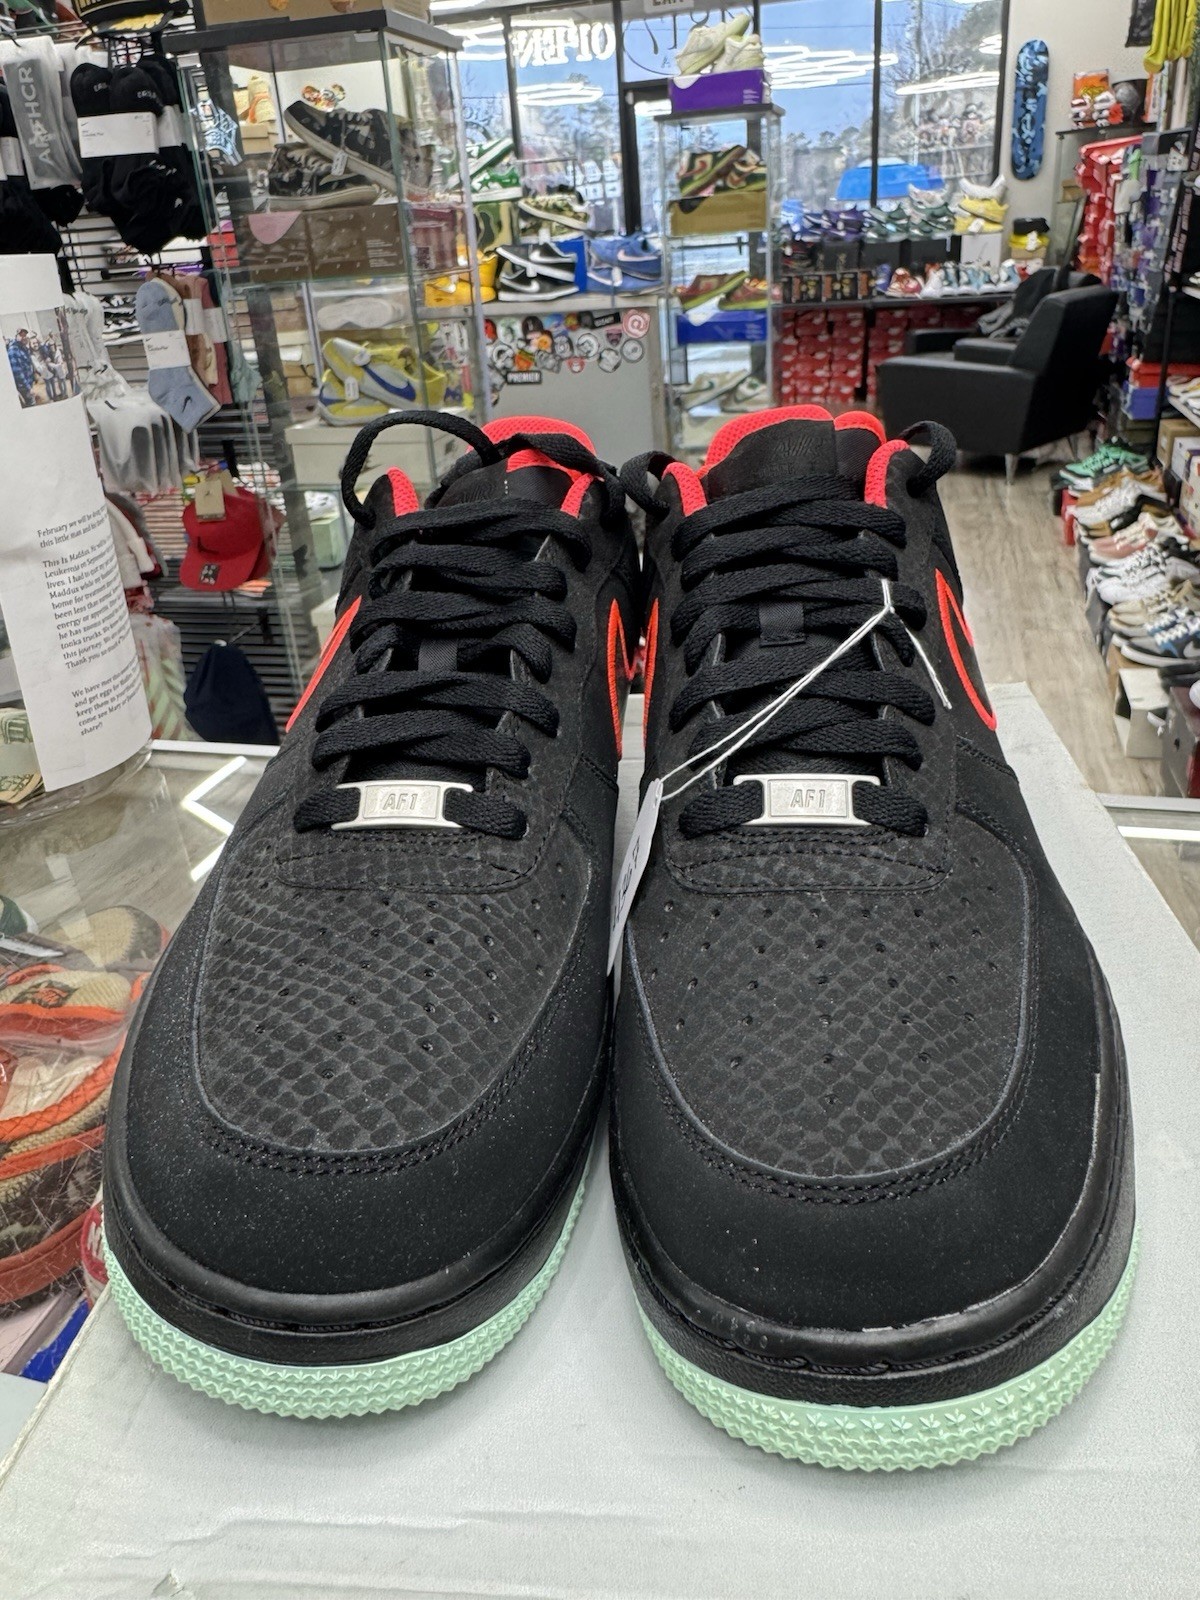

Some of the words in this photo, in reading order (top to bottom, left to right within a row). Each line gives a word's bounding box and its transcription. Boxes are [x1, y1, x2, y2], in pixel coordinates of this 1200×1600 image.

[37, 523, 67, 538] February
[40, 539, 54, 548] this
[54, 533, 69, 545] little
[42, 560, 60, 568] This
[44, 563, 80, 578] Leukemia
[72, 573, 84, 583] had
[49, 586, 79, 599] Maddux
[52, 600, 73, 610] home
[74, 595, 84, 604] for
[54, 610, 72, 620] been
[73, 605, 86, 614] less
[56, 618, 81, 630] energy
[59, 632, 68, 640] he
[69, 628, 82, 636] has
[61, 638, 82, 650] tonka
[63, 651, 77, 660] this
[65, 657, 88, 670] Thank
[88, 654, 100, 663] you
[72, 690, 84, 698] We
[84, 683, 100, 694] have
[74, 697, 87, 708] and
[88, 694, 99, 704] get
[100, 688, 112, 698] eggs
[76, 707, 93, 718] keep
[94, 700, 109, 710] them
[79, 715, 97, 727] come
[382, 793, 418, 810] AF1
[790, 788, 826, 808] AF1
